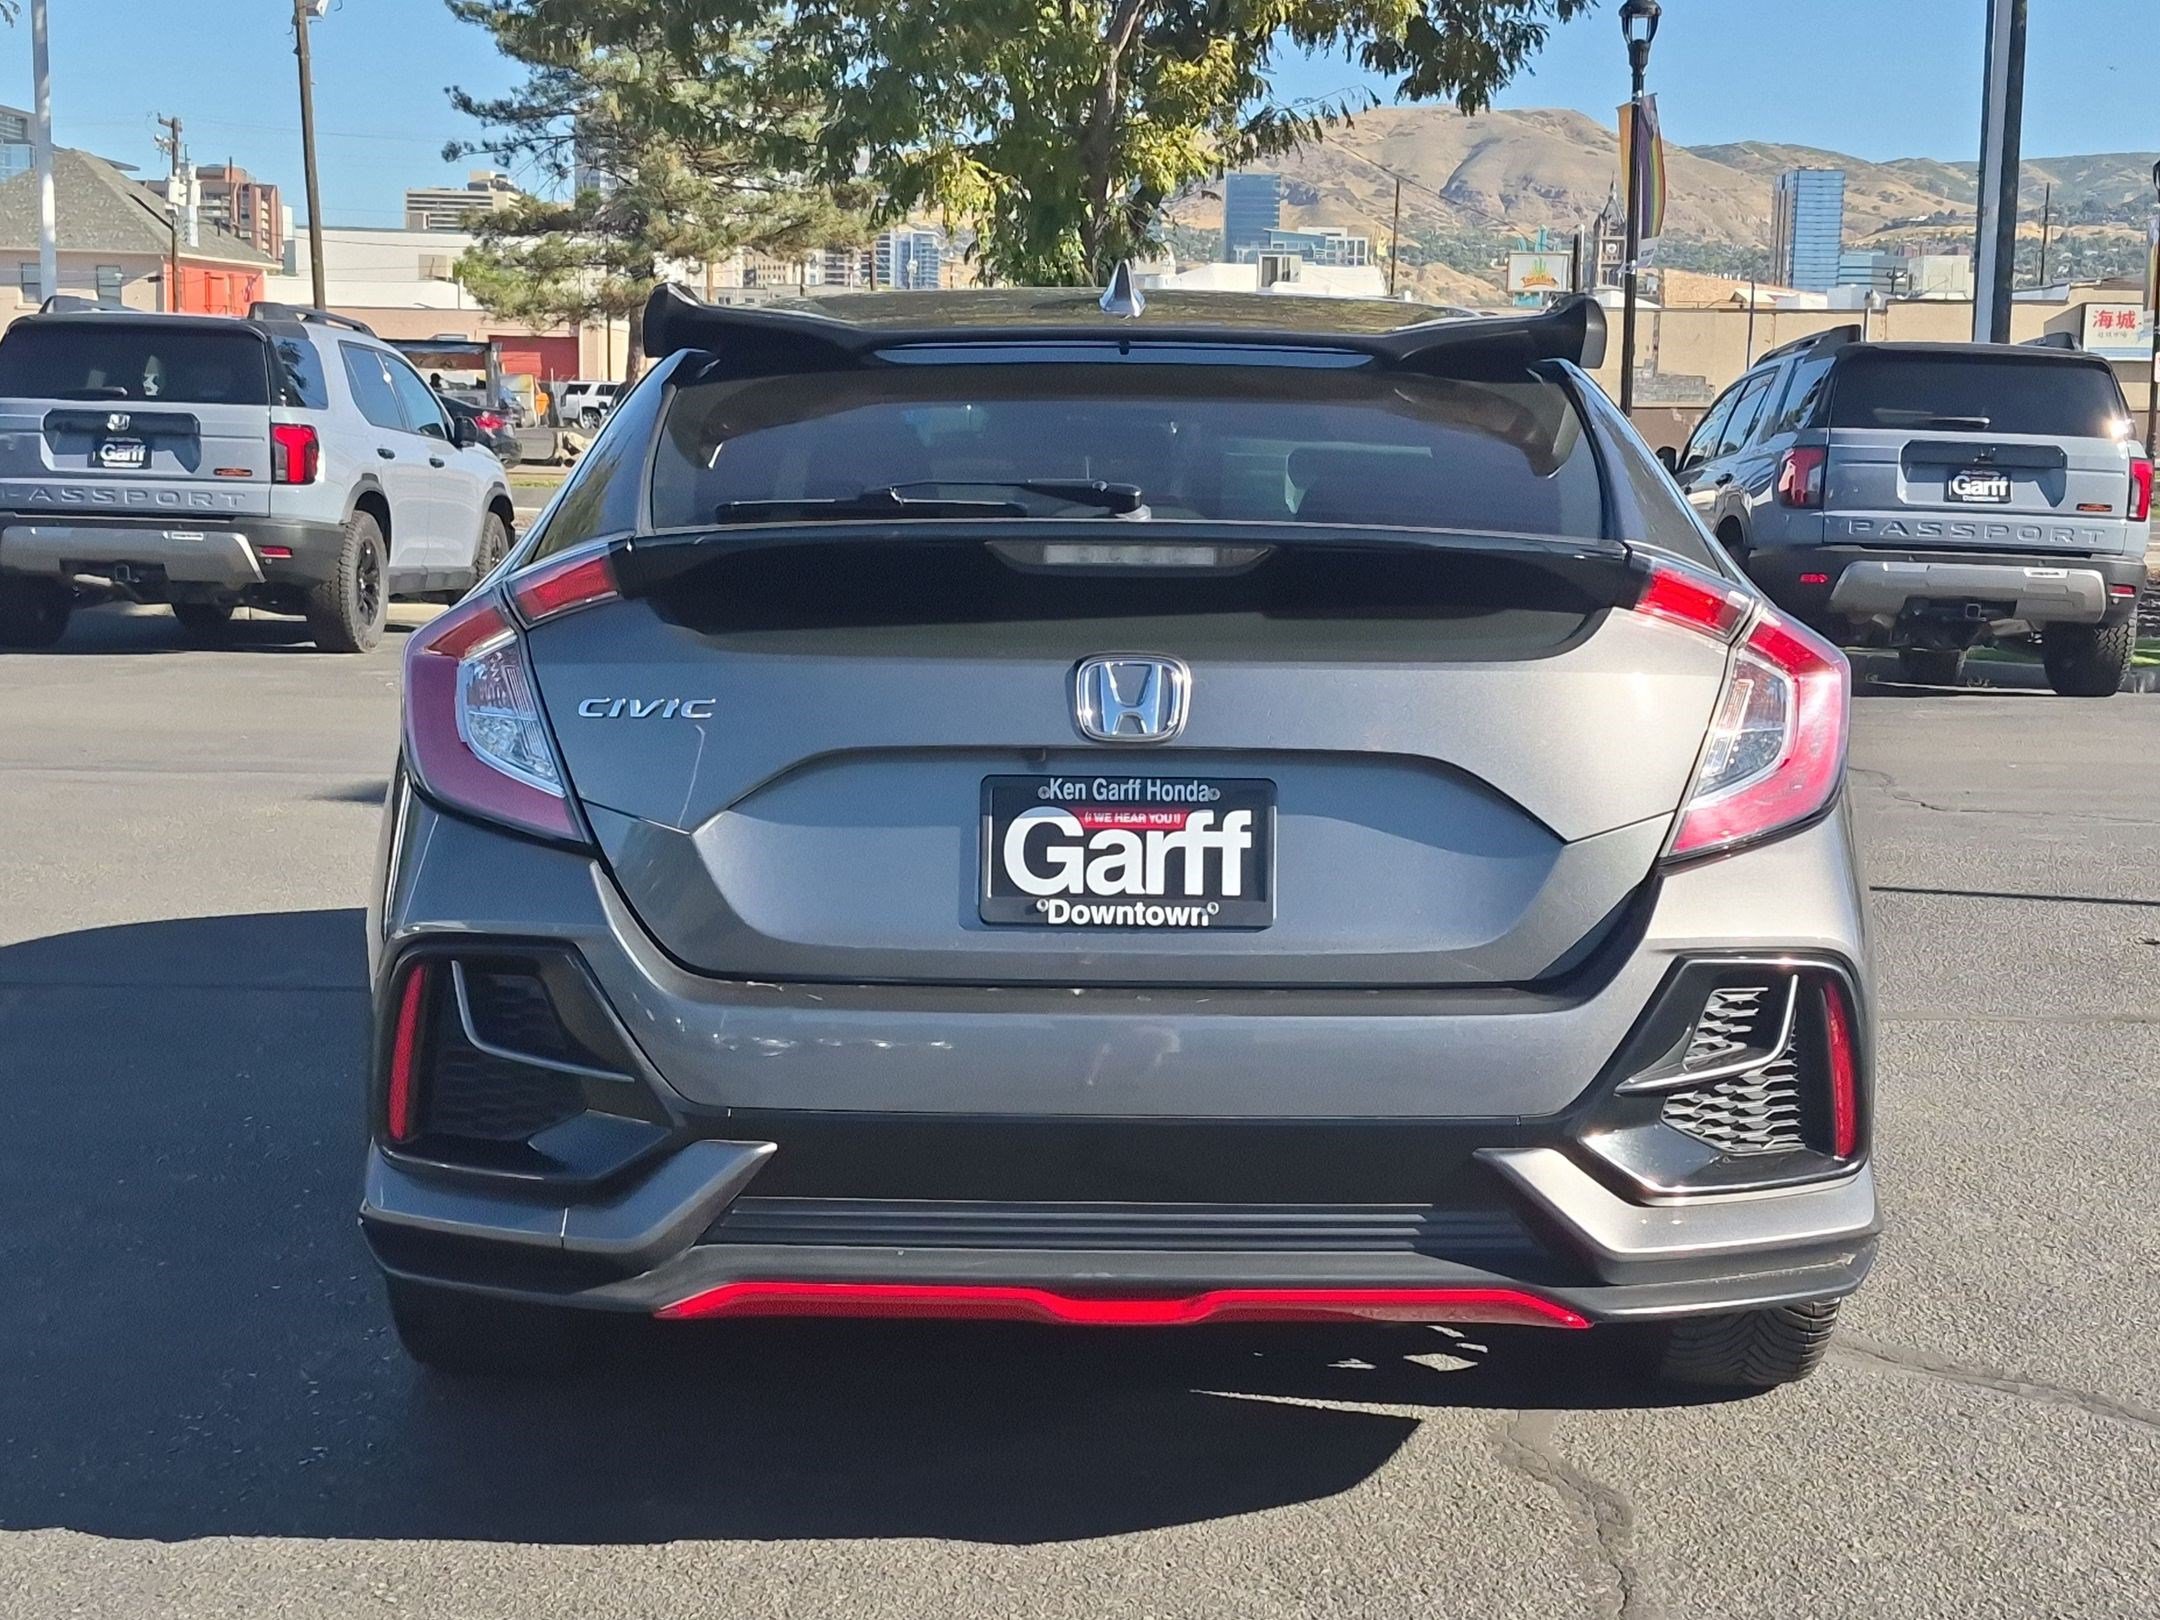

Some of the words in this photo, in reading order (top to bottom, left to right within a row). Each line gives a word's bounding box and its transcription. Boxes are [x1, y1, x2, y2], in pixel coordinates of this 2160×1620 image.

[2092, 309, 2142, 330] 海城
[100, 443, 146, 462] Garff
[1952, 474, 2008, 497] Garff
[1848, 519, 2105, 545] PASSPORT
[578, 697, 716, 719] CIVIC
[1050, 778, 1086, 800] Ken
[1092, 778, 1142, 801] Garff
[1147, 780, 1210, 802] Honda
[1094, 812, 1113, 823] WE
[1115, 812, 1146, 823] HEAR
[1149, 813, 1172, 824] YOU
[1003, 806, 1252, 896] Garff
[1048, 899, 1209, 926] Downtown
